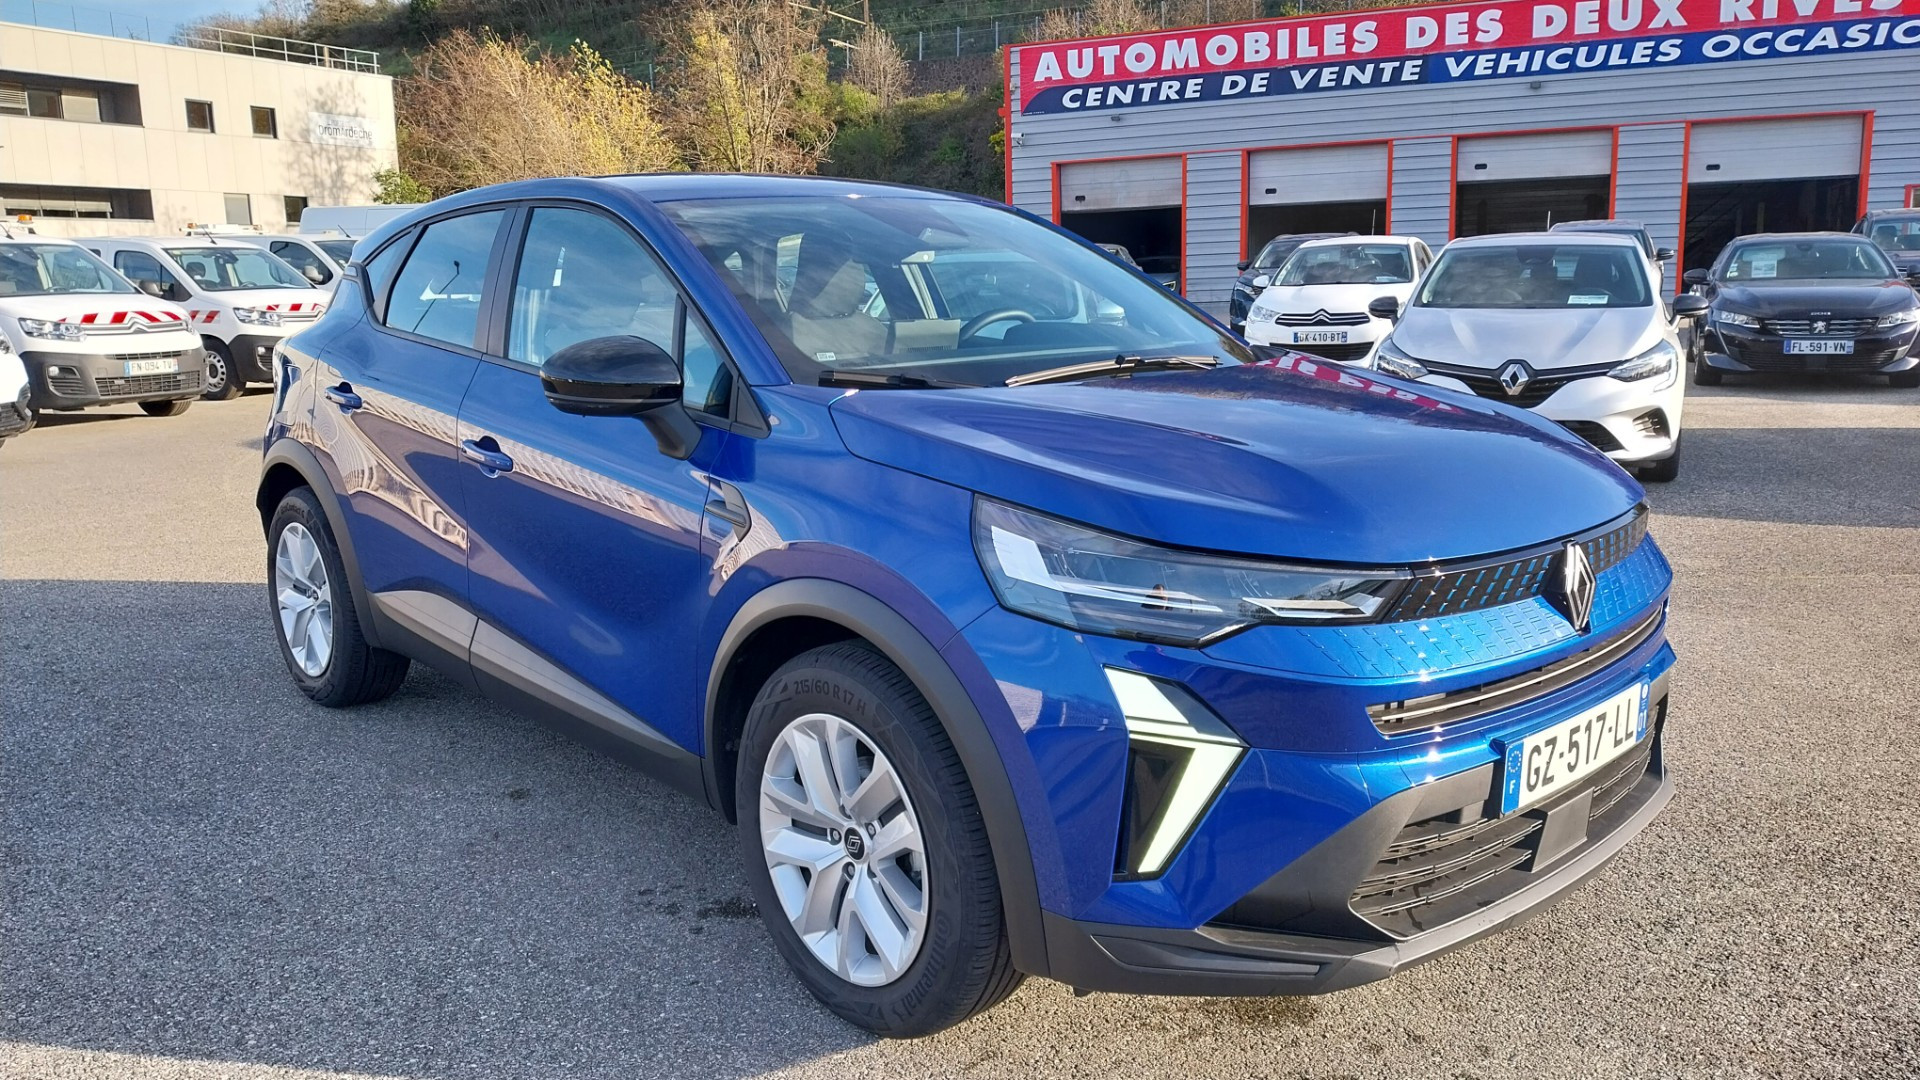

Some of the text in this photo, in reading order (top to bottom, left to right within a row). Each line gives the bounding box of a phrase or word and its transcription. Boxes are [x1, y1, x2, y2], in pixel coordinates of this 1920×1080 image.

[1033, 20, 1379, 82] AUTOMOBILES
[1405, 9, 1504, 49] DES
[1532, 0, 1688, 38] DEUX
[1061, 78, 1204, 108] CENTRE
[1220, 72, 1270, 96] DE
[1289, 59, 1423, 90] VENTE
[1445, 39, 1683, 77] VEHICULES
[1792, 342, 1846, 352] FL-591-VN
[794, 679, 866, 715] 215/60 R 17 H
[1526, 698, 1634, 792] GZ-517-LL
[1509, 779, 1516, 794] F
